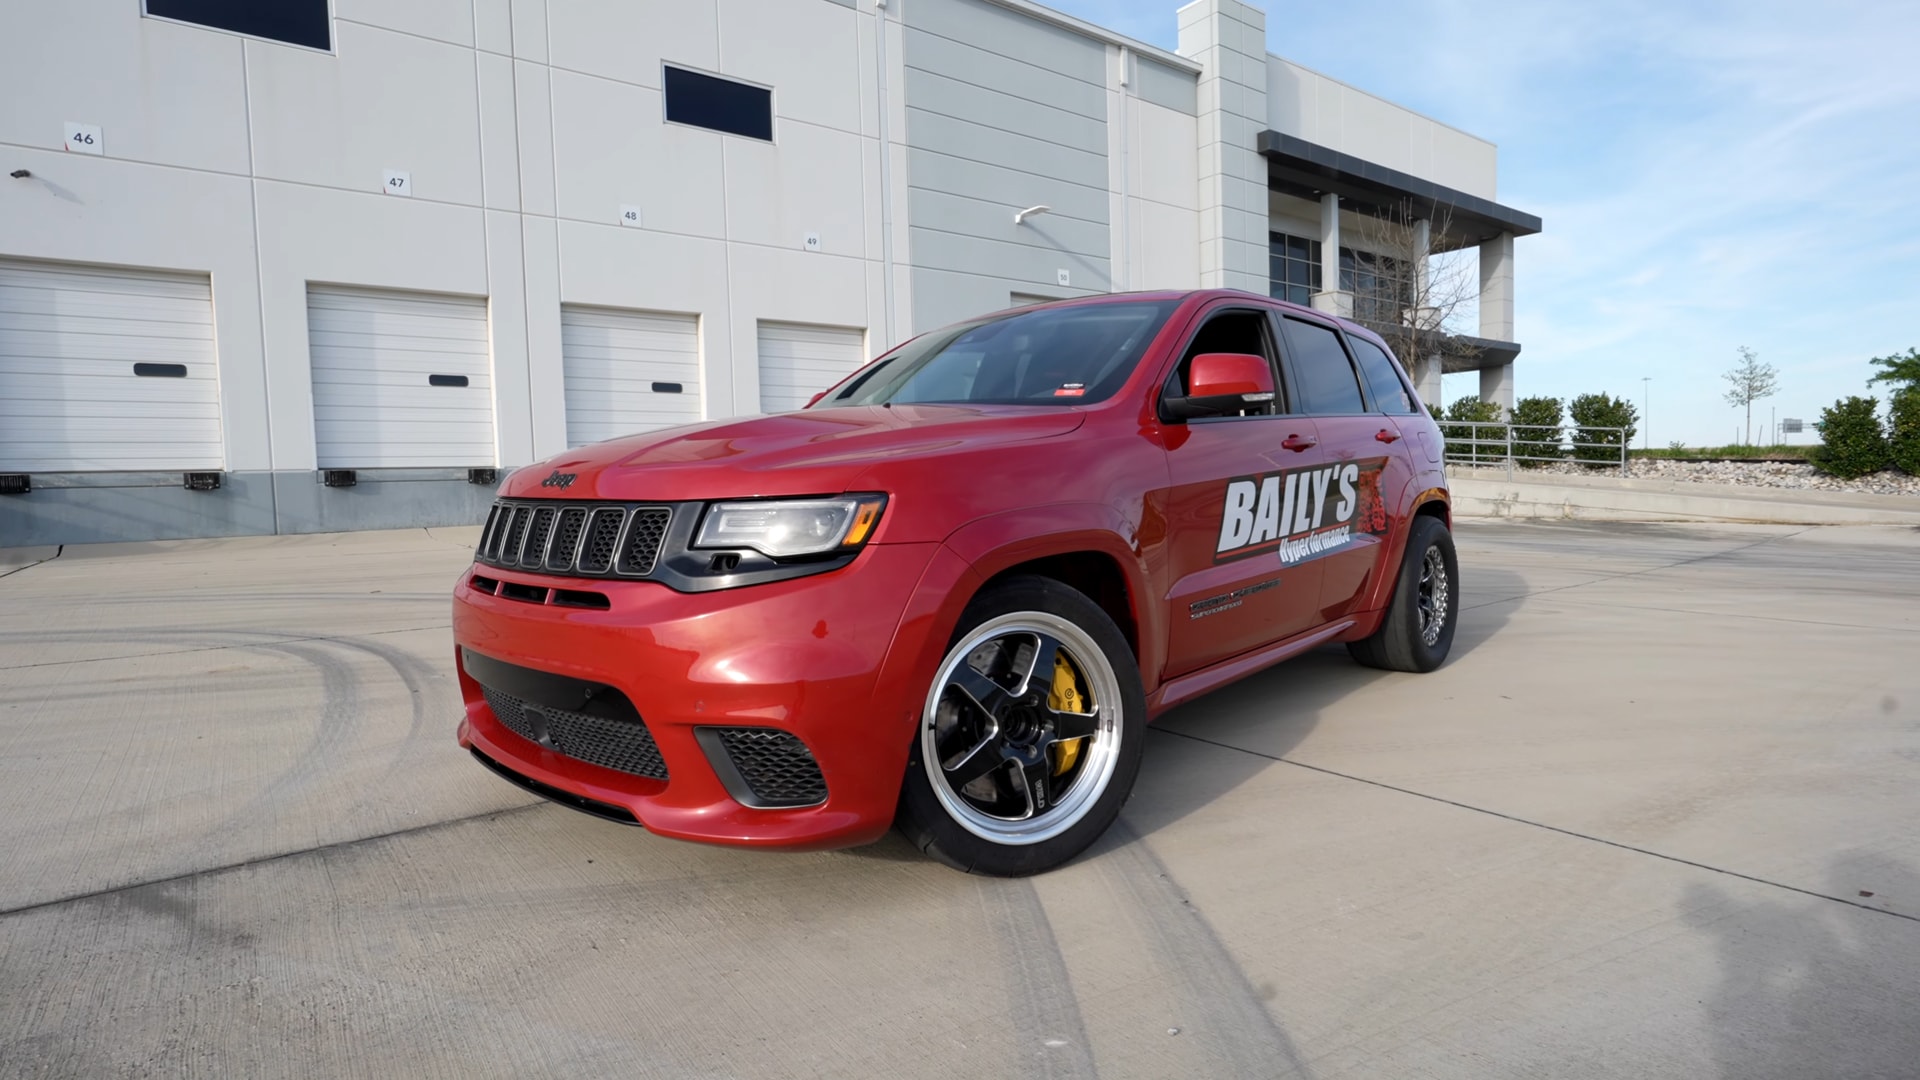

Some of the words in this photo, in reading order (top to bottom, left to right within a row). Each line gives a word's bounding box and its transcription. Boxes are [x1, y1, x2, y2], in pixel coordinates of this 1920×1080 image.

[73, 132, 94, 145] 46
[389, 177, 404, 188] 47
[625, 211, 637, 221] 48
[807, 237, 817, 246] 49
[541, 470, 578, 491] Jeep
[1217, 464, 1359, 553] BAILY'S
[1279, 524, 1351, 563] Hyperformance
